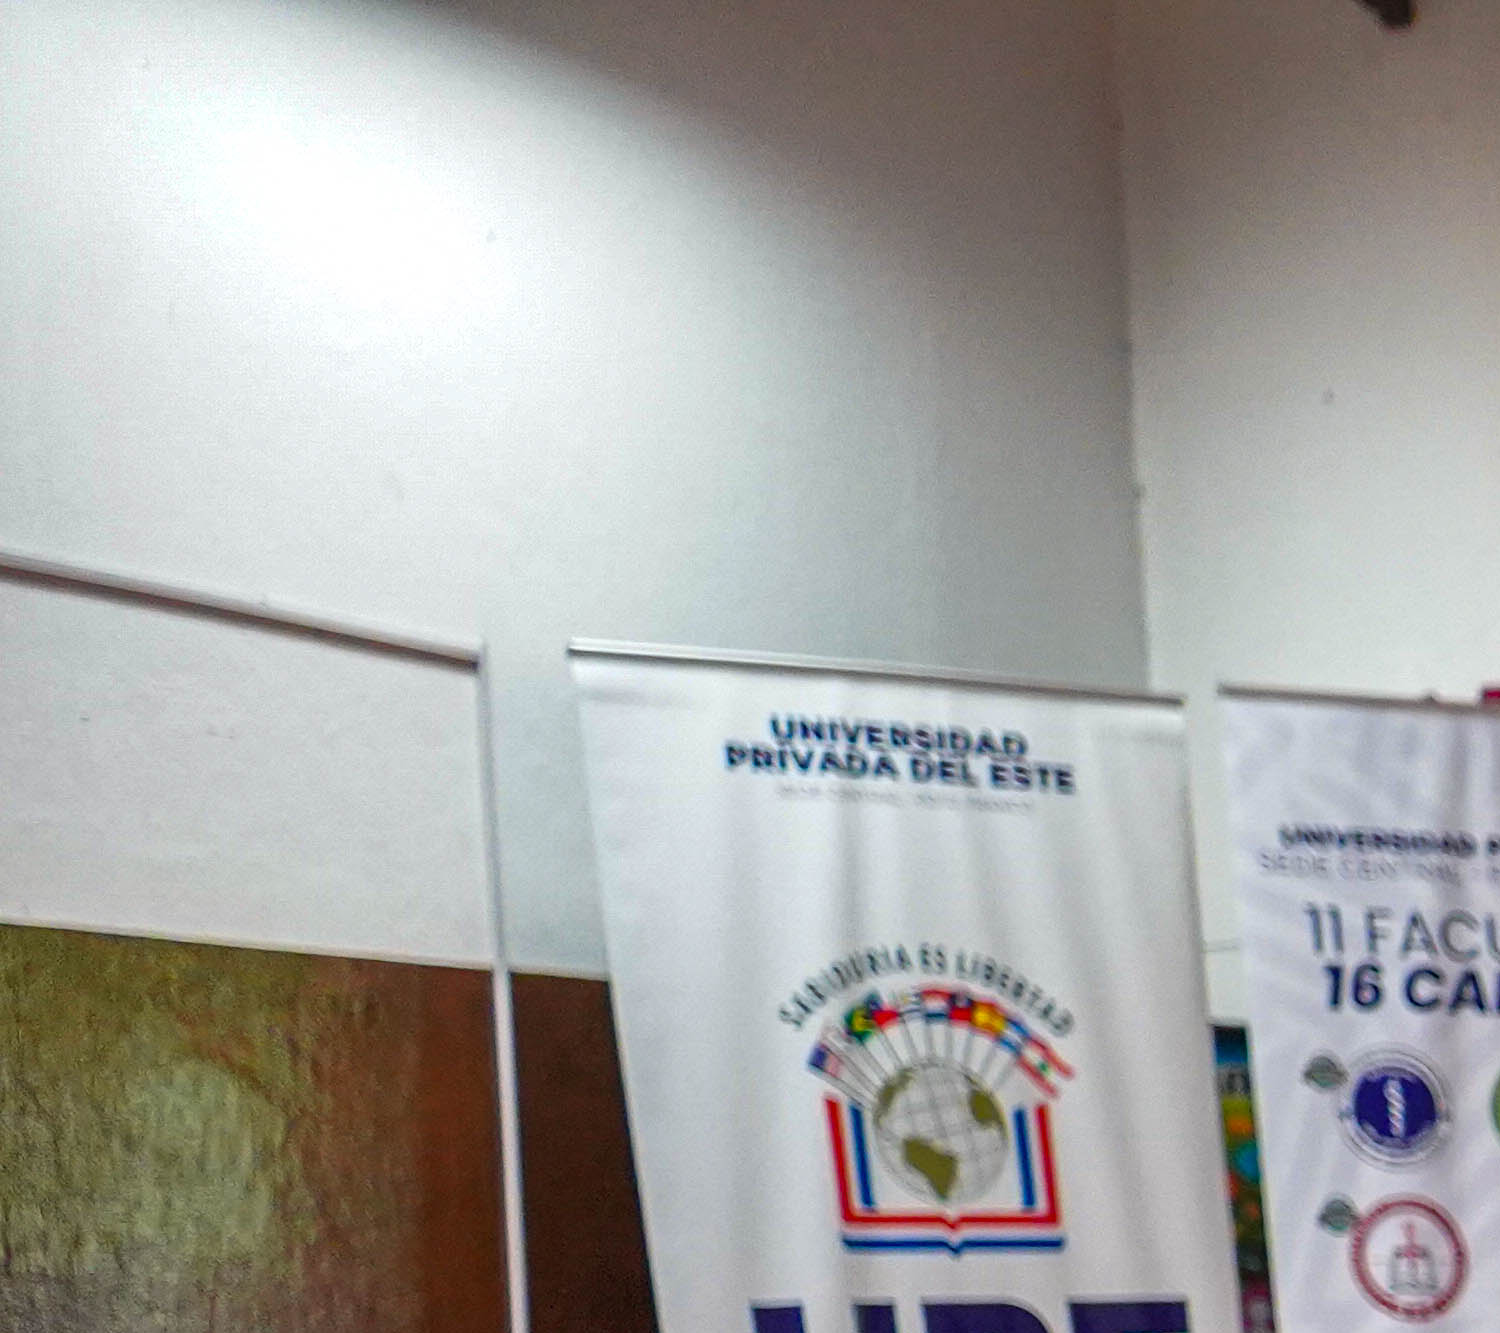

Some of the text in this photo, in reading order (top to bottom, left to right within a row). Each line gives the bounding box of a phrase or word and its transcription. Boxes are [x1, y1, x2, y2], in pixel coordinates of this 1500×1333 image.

[770, 712, 1029, 759] UNIVERSIDAD
[726, 739, 1076, 796] PRIVADA DEL ESTE
[1278, 823, 1477, 858] UNIVERSIDAD
[1304, 903, 1346, 954] 11
[1325, 963, 1384, 1012] 16
